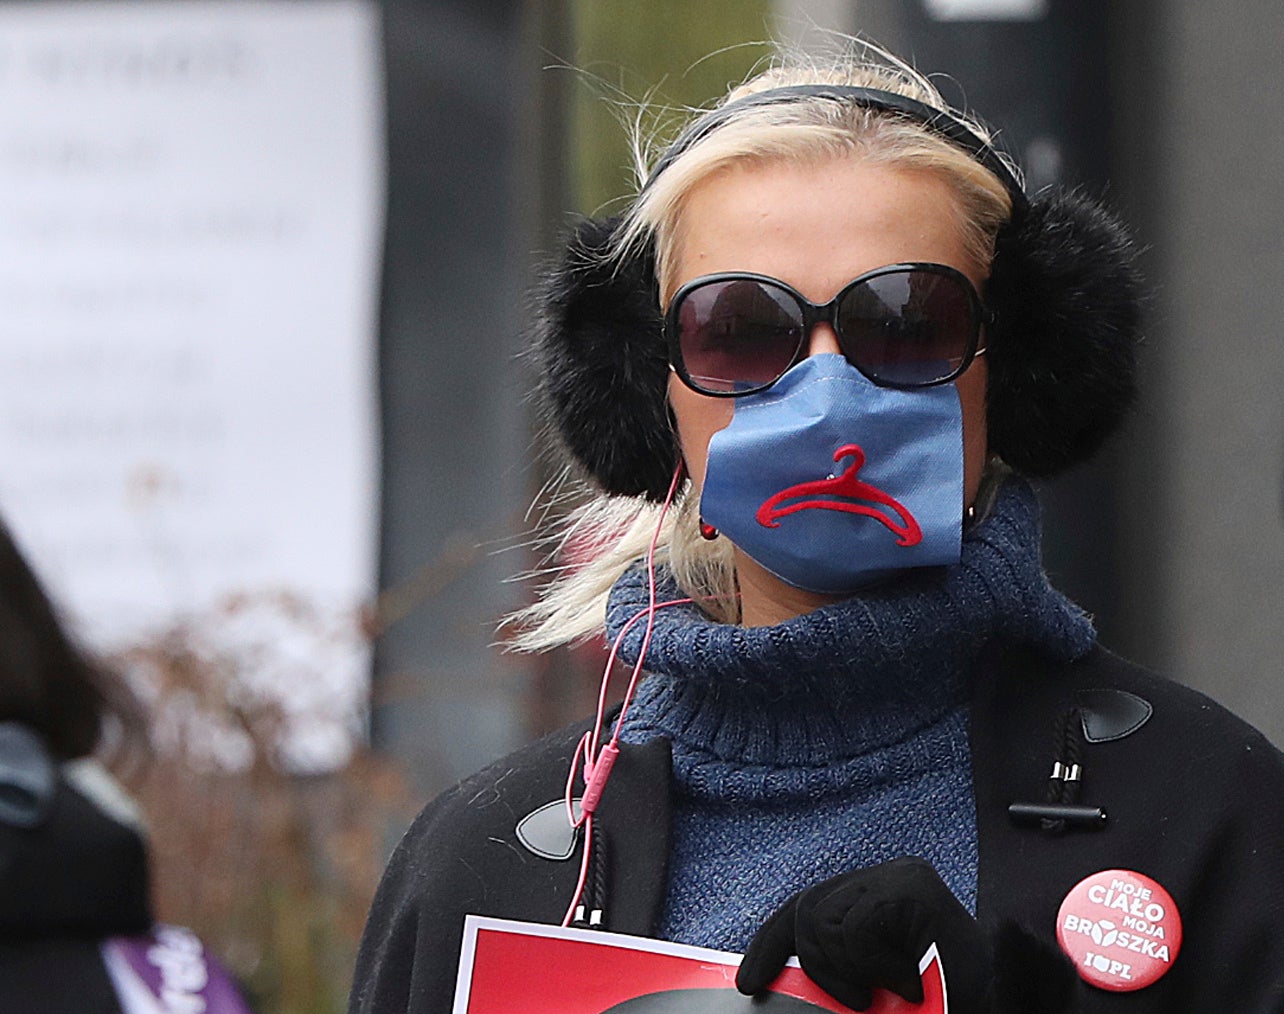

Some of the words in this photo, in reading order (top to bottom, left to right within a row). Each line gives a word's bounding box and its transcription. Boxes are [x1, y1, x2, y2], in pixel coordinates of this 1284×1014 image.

[1111, 879, 1152, 901] MOJE
[1088, 885, 1165, 922] CIAŁO
[1122, 916, 1165, 940] MOJA
